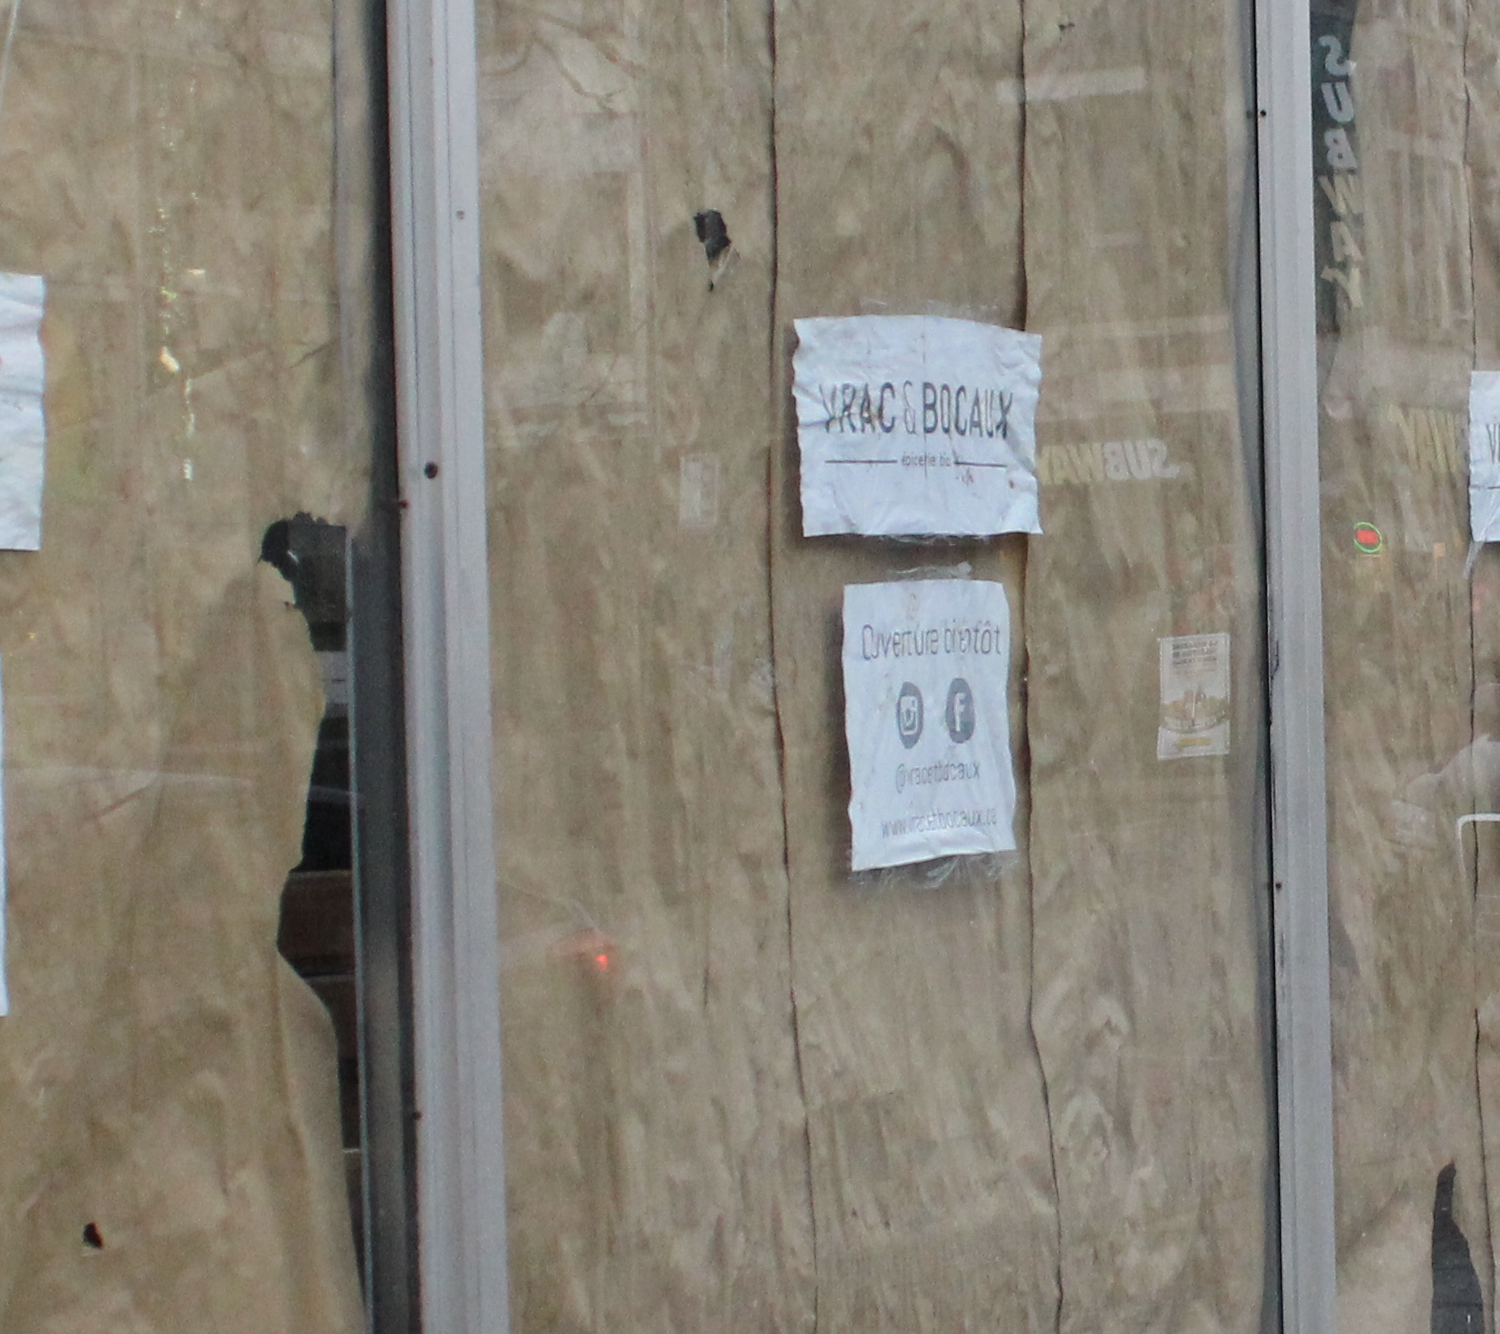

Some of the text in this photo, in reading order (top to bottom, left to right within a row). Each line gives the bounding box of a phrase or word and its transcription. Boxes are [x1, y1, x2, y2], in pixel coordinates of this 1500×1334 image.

[818, 380, 1014, 440] VRAC & BOCAUX
[861, 624, 939, 662] Ouverture
